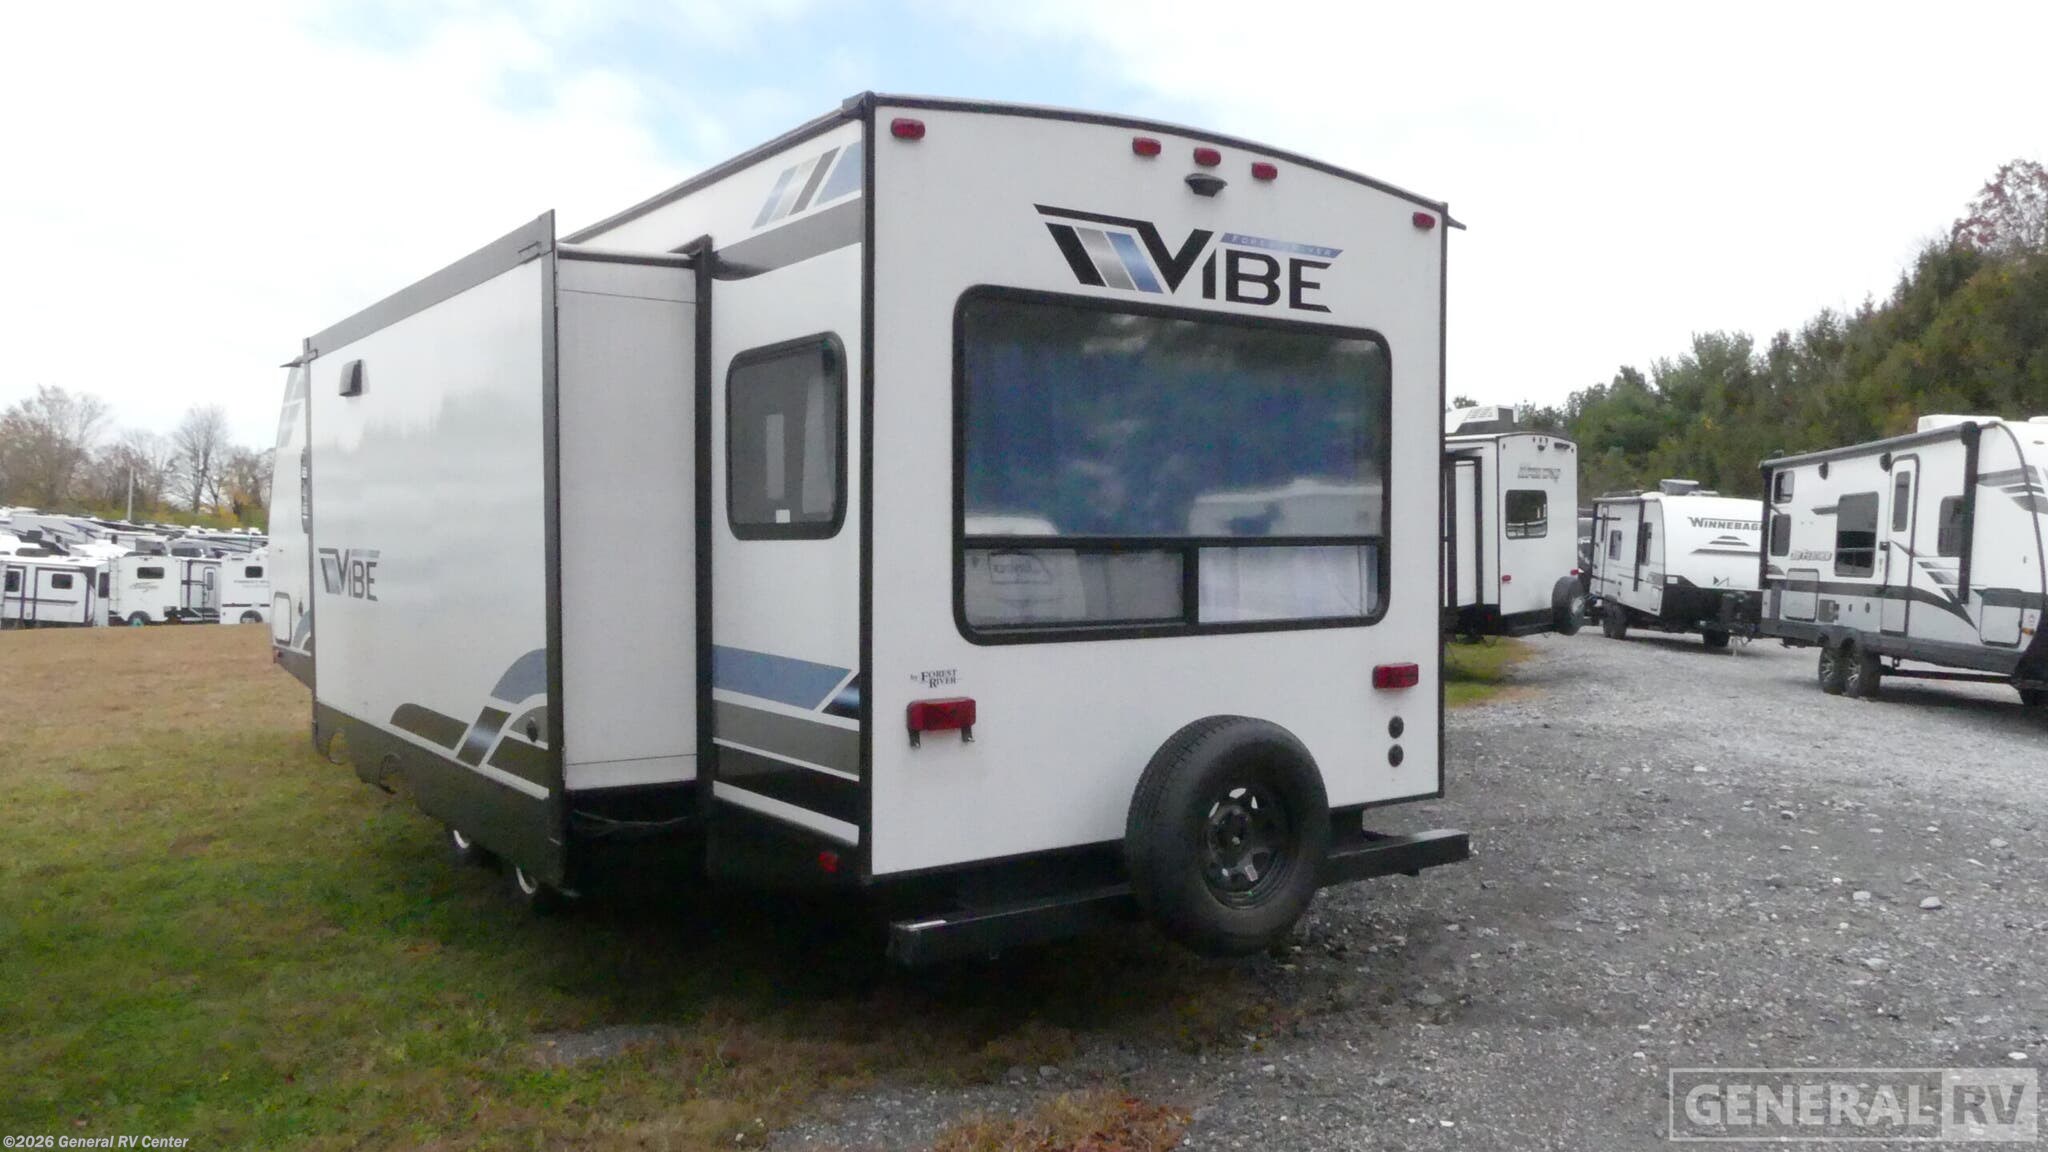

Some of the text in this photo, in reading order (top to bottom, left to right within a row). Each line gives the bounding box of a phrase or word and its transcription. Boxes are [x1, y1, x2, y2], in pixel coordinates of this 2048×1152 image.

[1034, 203, 1332, 313] VIBE
[1687, 516, 1761, 531] WINNEBAG
[319, 548, 378, 601] VIBE
[920, 669, 957, 681] FOREST
[929, 677, 957, 688] RIVER
